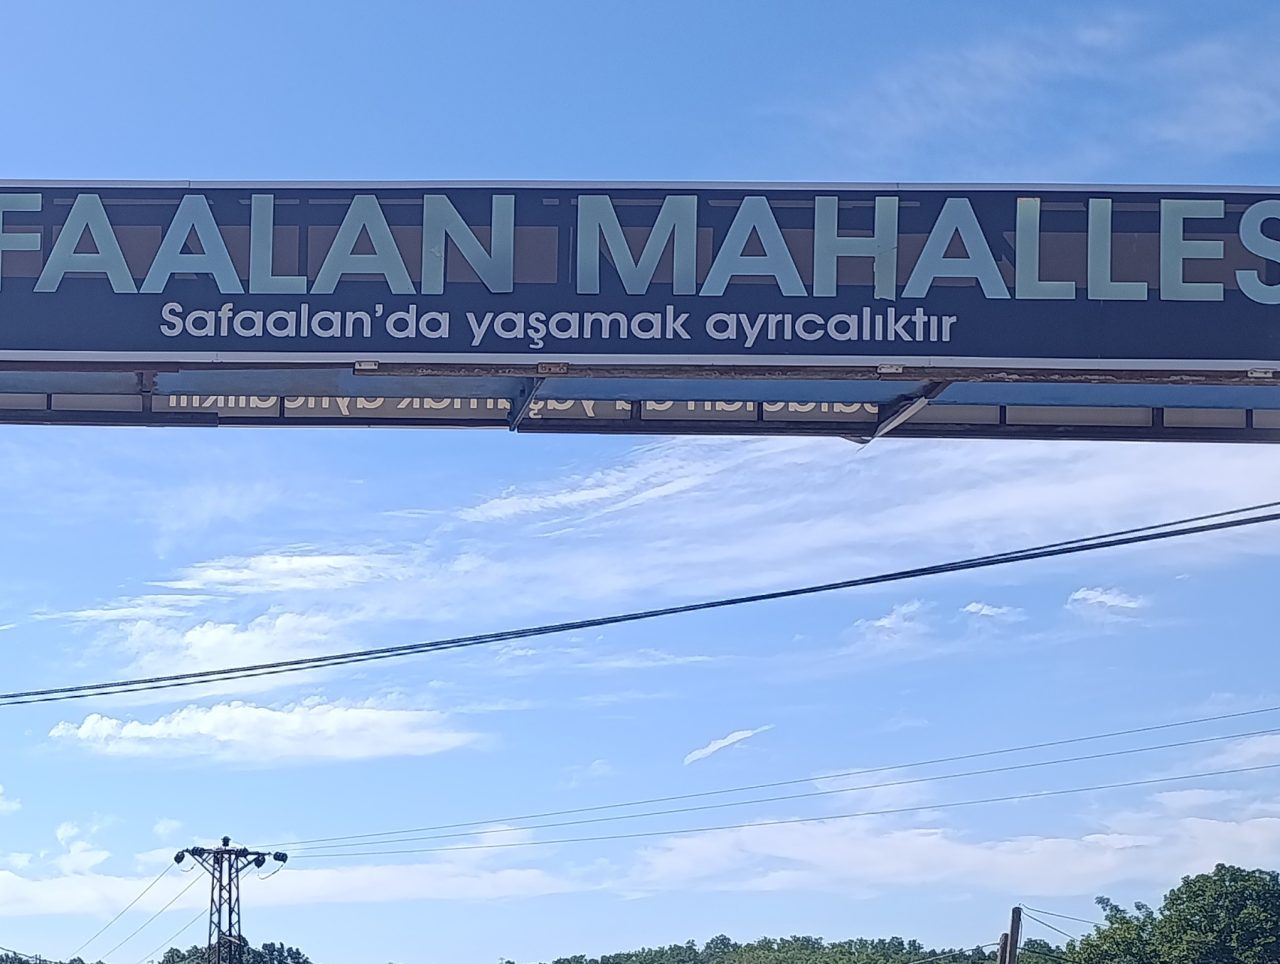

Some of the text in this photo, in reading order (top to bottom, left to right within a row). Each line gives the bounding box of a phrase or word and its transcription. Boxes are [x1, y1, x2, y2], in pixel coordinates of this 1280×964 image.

[576, 194, 1280, 304] MAHALLES
[159, 302, 958, 349] Safaalan'da yaşamak ayrıcalıktır
